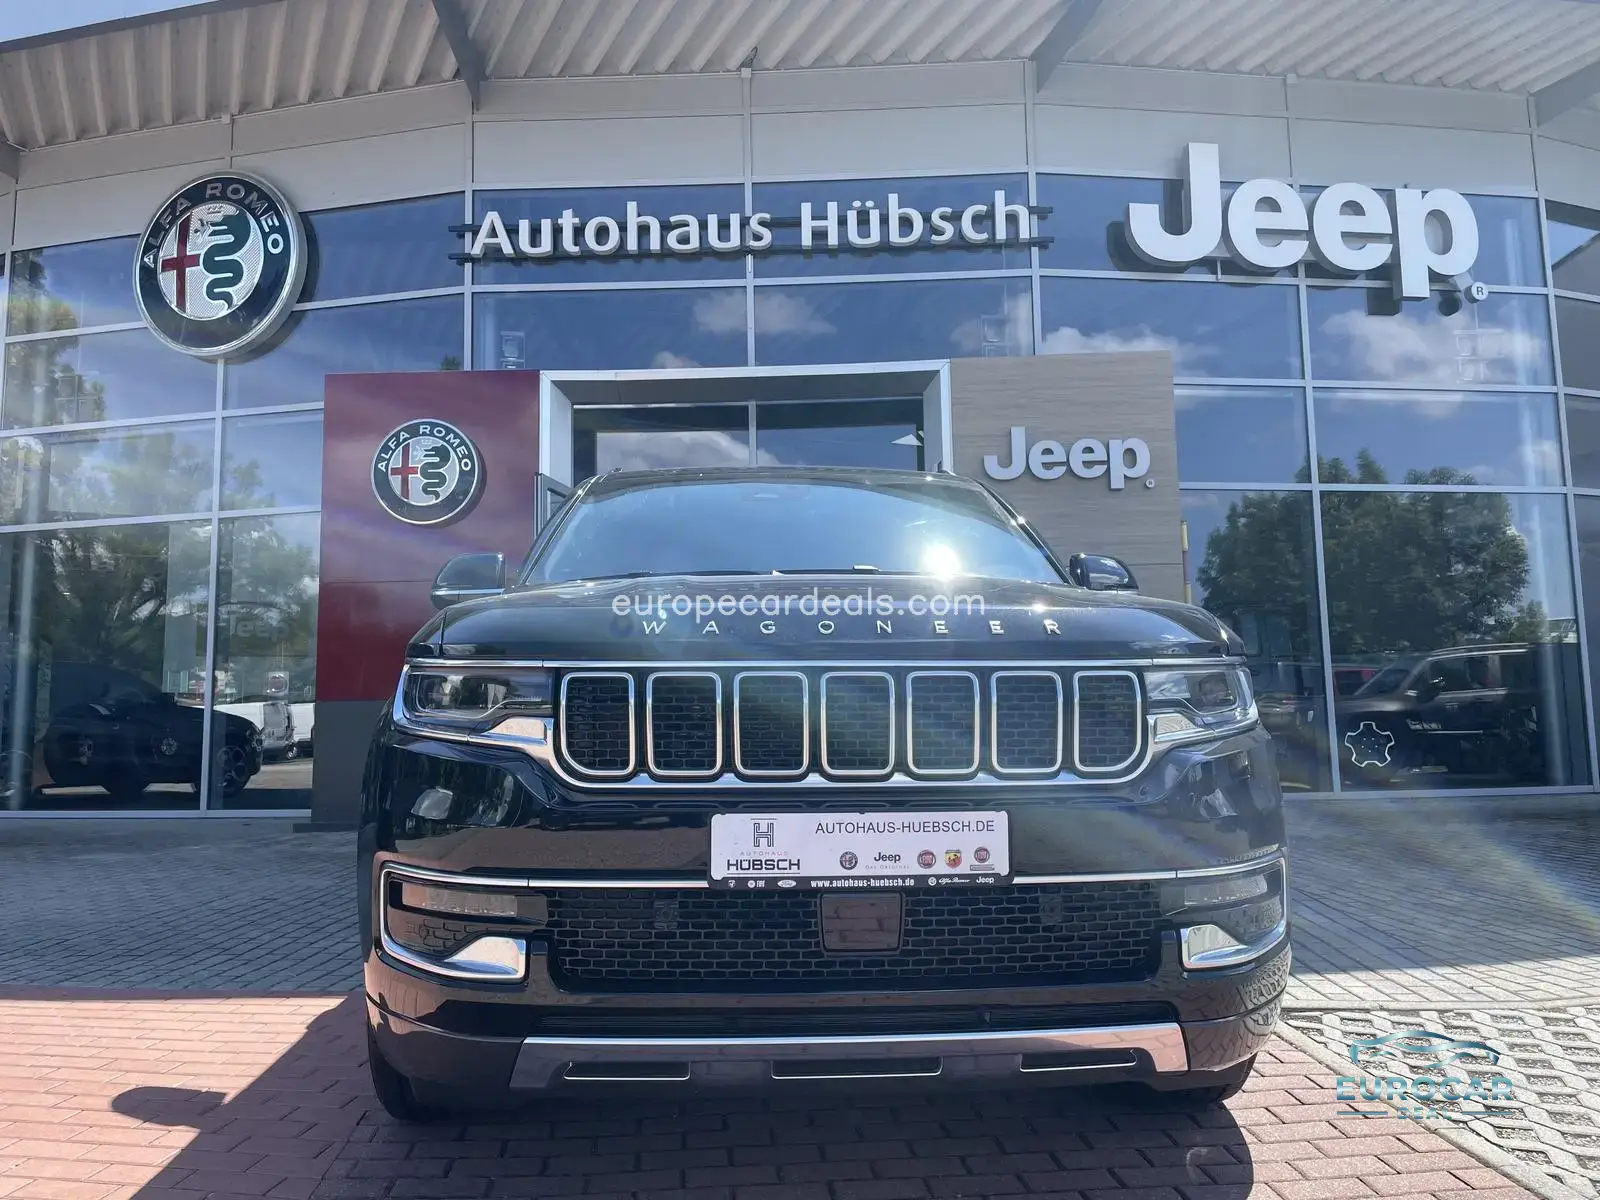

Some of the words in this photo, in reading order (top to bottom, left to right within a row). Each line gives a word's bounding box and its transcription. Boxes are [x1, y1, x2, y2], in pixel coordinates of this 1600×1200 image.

[143, 197, 192, 268] ALFA
[205, 182, 284, 255] ROMEO
[470, 201, 773, 258] Autohaus
[800, 189, 1032, 250] Hübsch
[1128, 142, 1479, 299] Jeep
[377, 431, 410, 472] ALFA
[419, 424, 471, 472] ROMEO
[983, 426, 1151, 490] Jeep
[643, 619, 1062, 636] WAGONEER
[815, 820, 995, 834] AUTOHAUS-HUEBSCH.DE
[726, 858, 801, 871] HÜBSCH
[873, 852, 902, 864] Jeep
[810, 878, 915, 888] www.autohaus-huebsch.de
[976, 876, 995, 884] Jeep
